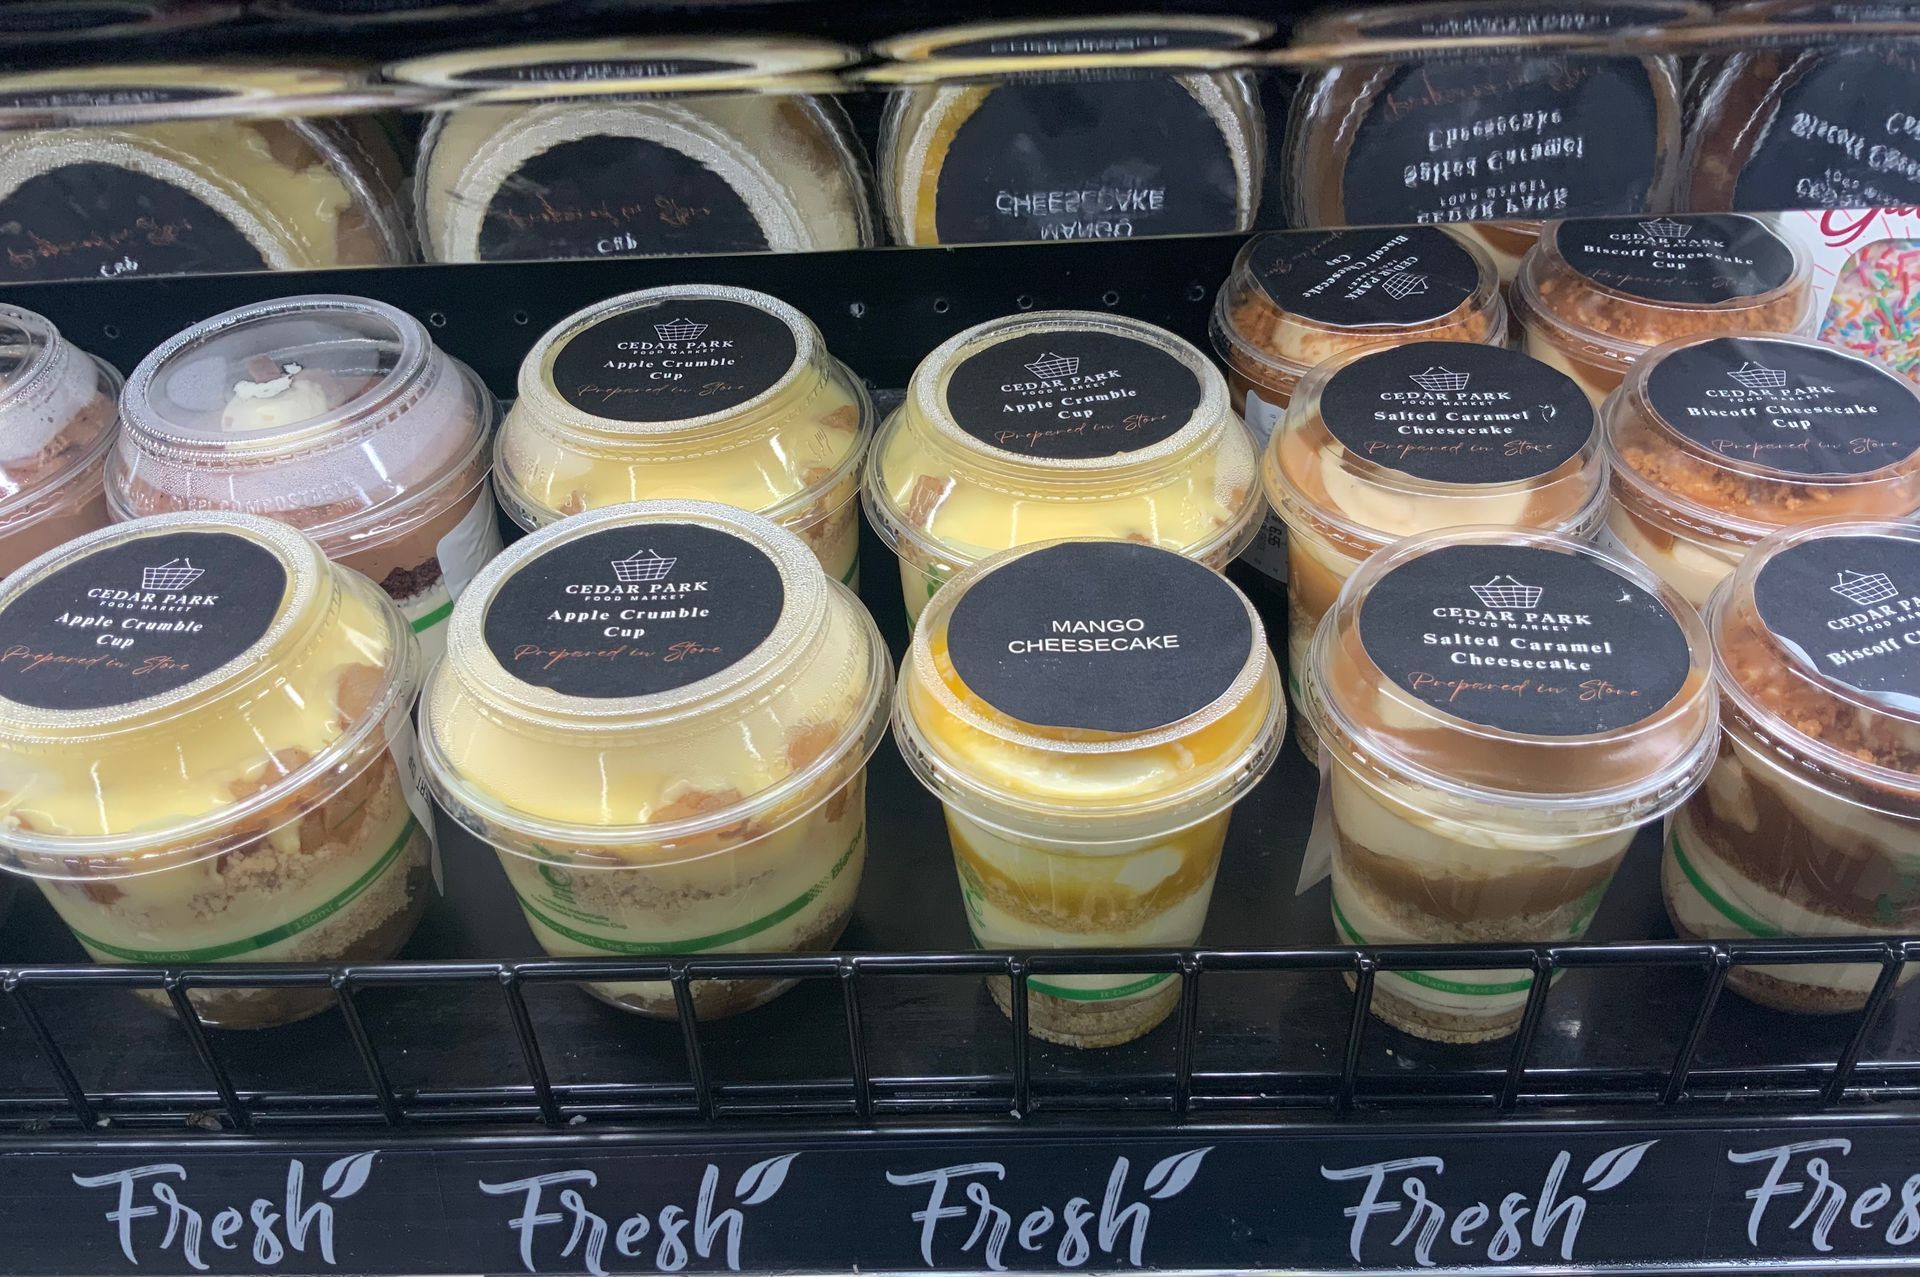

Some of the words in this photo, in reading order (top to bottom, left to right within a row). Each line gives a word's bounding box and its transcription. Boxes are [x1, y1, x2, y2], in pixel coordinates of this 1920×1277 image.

[1366, 235, 1409, 263] Biscoff
[1609, 233, 1669, 244] CEDAR
[1680, 239, 1725, 248] PARK
[1584, 245, 1644, 258] Biscoff
[1653, 250, 1754, 266] Cheesecake
[1378, 256, 1418, 277] CEDAR
[1652, 261, 1686, 271] Cup
[1302, 261, 1367, 298] Cheesecake
[1344, 276, 1381, 300] PARK
[617, 342, 677, 350] CEDAR
[686, 340, 734, 349] PARK
[603, 360, 654, 369] Apple
[662, 358, 735, 367] Crumble
[650, 372, 683, 380] Cup
[1000, 379, 1064, 393] CEDAR
[1071, 370, 1122, 385] PARK
[578, 384, 669, 402] Prepared
[699, 382, 744, 396] Store
[1060, 382, 1105, 392] MARKET
[1380, 392, 1448, 400] CEDAR
[1456, 392, 1511, 400] PARK
[1705, 389, 1773, 397] CEDAR
[1781, 386, 1836, 396] PARK
[1003, 401, 1053, 413] Apple
[1061, 389, 1137, 406] Crumble
[1058, 409, 1094, 419] Cup
[1374, 411, 1436, 421] Salted
[1446, 411, 1528, 421] Caramel
[1687, 407, 1758, 417] Biscoff
[1765, 404, 1878, 415] Cheesecake
[995, 423, 1086, 447] Prepared
[1123, 414, 1167, 432] Store
[1398, 425, 1513, 434] Cheesecake
[1773, 419, 1811, 430] Cup
[1364, 440, 1463, 459] Prepared
[1504, 440, 1552, 456] Store
[1712, 438, 1810, 458] Prepared
[1848, 438, 1899, 454] Store
[87, 588, 156, 603] CEDAR
[162, 595, 220, 605] PARK
[566, 584, 640, 594] CEDAR
[649, 581, 708, 593] PARK
[100, 601, 134, 609] FOOD
[54, 612, 113, 629] Apple
[121, 618, 204, 632] Crumble
[547, 610, 610, 623] Apple
[620, 607, 710, 620] Crumble
[1433, 608, 1516, 622] CEDAR
[1525, 612, 1592, 625] PARK
[1827, 604, 1897, 630] CEDAR
[603, 626, 645, 639] Cup
[1052, 618, 1145, 633] MANGO
[1459, 619, 1498, 628] FOOD
[1508, 623, 1569, 632] MARKET
[1858, 621, 1892, 634] FOOD
[97, 634, 135, 649] Cup
[1008, 635, 1180, 653] CHEESECAKE
[1423, 633, 1500, 647] Salted
[1510, 638, 1612, 654] Caramel
[1, 645, 109, 673] Prepared
[132, 655, 190, 675] Store
[514, 644, 628, 670] Prepared
[663, 641, 722, 662] Store
[1450, 651, 1591, 671] Cheesecake
[1826, 638, 1901, 666] Biscoff
[1408, 672, 1530, 702] Prepared
[1578, 680, 1641, 701] Store
[73, 1158, 338, 1269] Fresh
[885, 1155, 1150, 1271] Fresh
[1320, 1150, 1581, 1269] Fresh
[480, 1163, 742, 1277] Fresh
